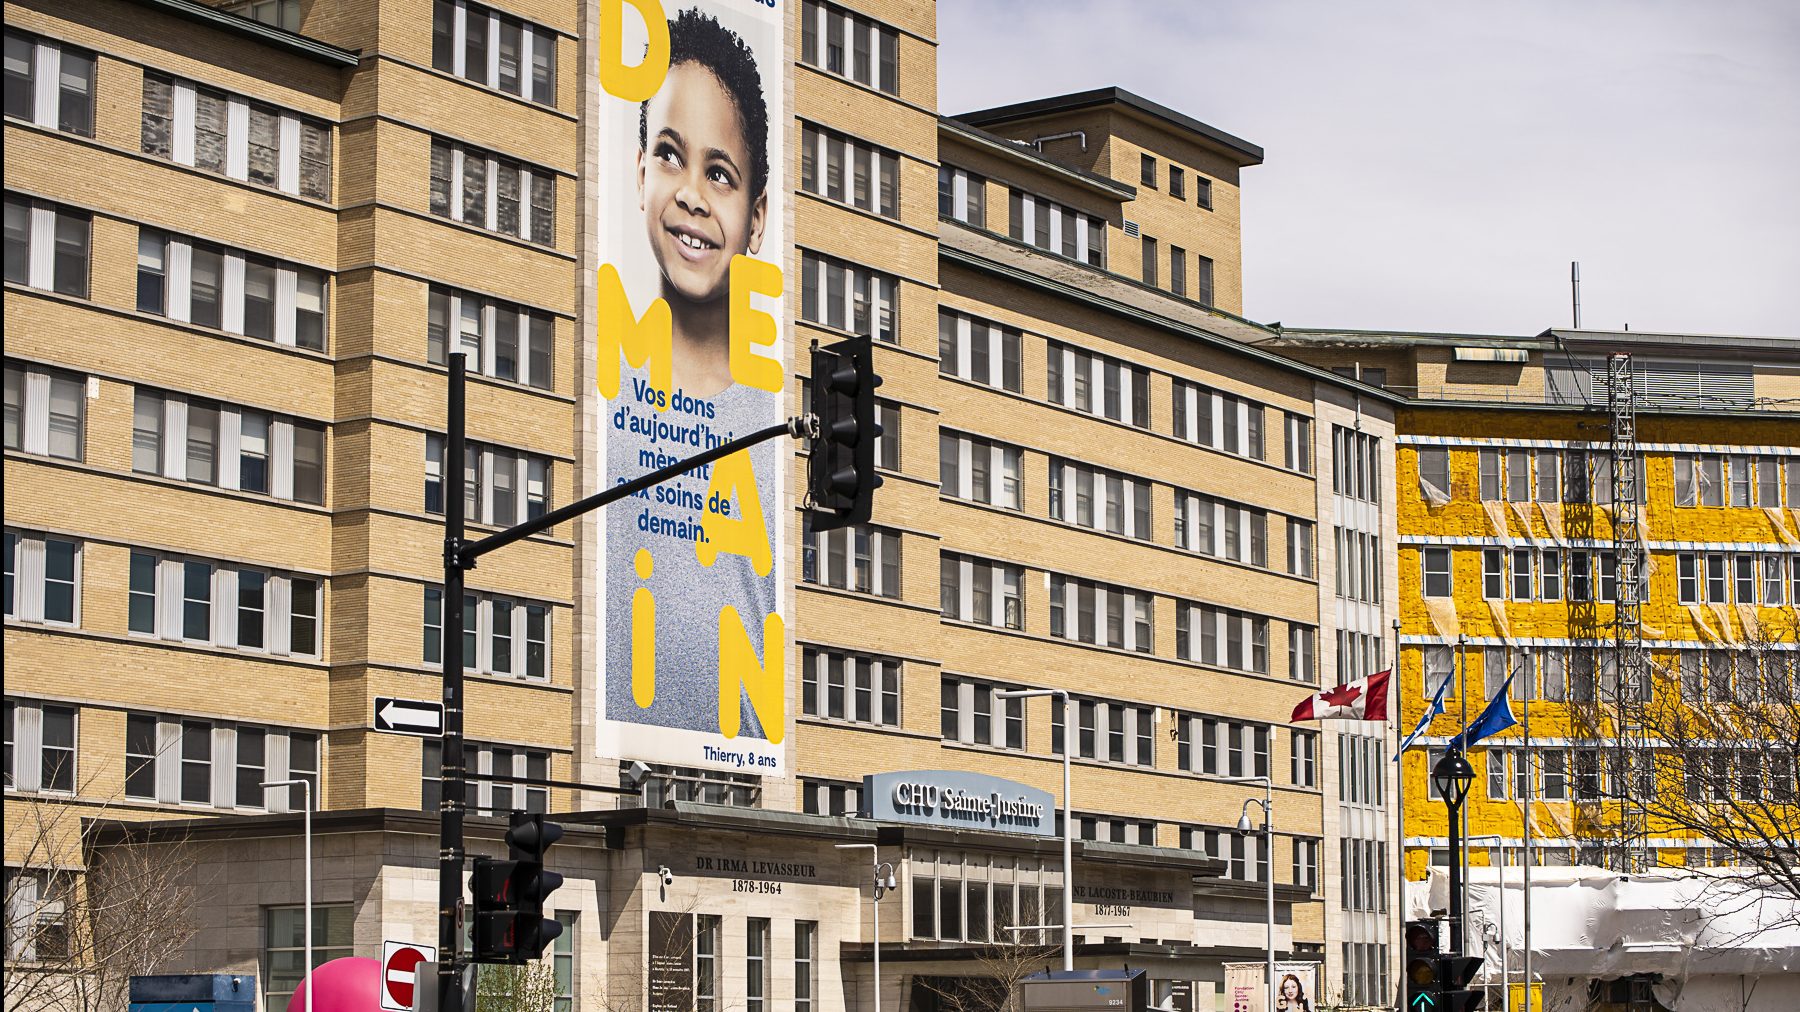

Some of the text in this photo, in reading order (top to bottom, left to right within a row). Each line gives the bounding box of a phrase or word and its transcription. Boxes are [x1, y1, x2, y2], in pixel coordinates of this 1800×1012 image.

[632, 377, 715, 419] Vos dons
[639, 447, 709, 481] mènnt
[656, 482, 703, 511] soins
[708, 490, 731, 516] de
[637, 508, 710, 544] demain.
[703, 745, 777, 768] Thierry, 8 ans
[896, 782, 1044, 819] CHU Sainte-Justine
[696, 856, 816, 878] DR IRMA LEVASSEUR
[732, 879, 782, 895] 1878-1964
[1095, 904, 1131, 917] 1877-1967
